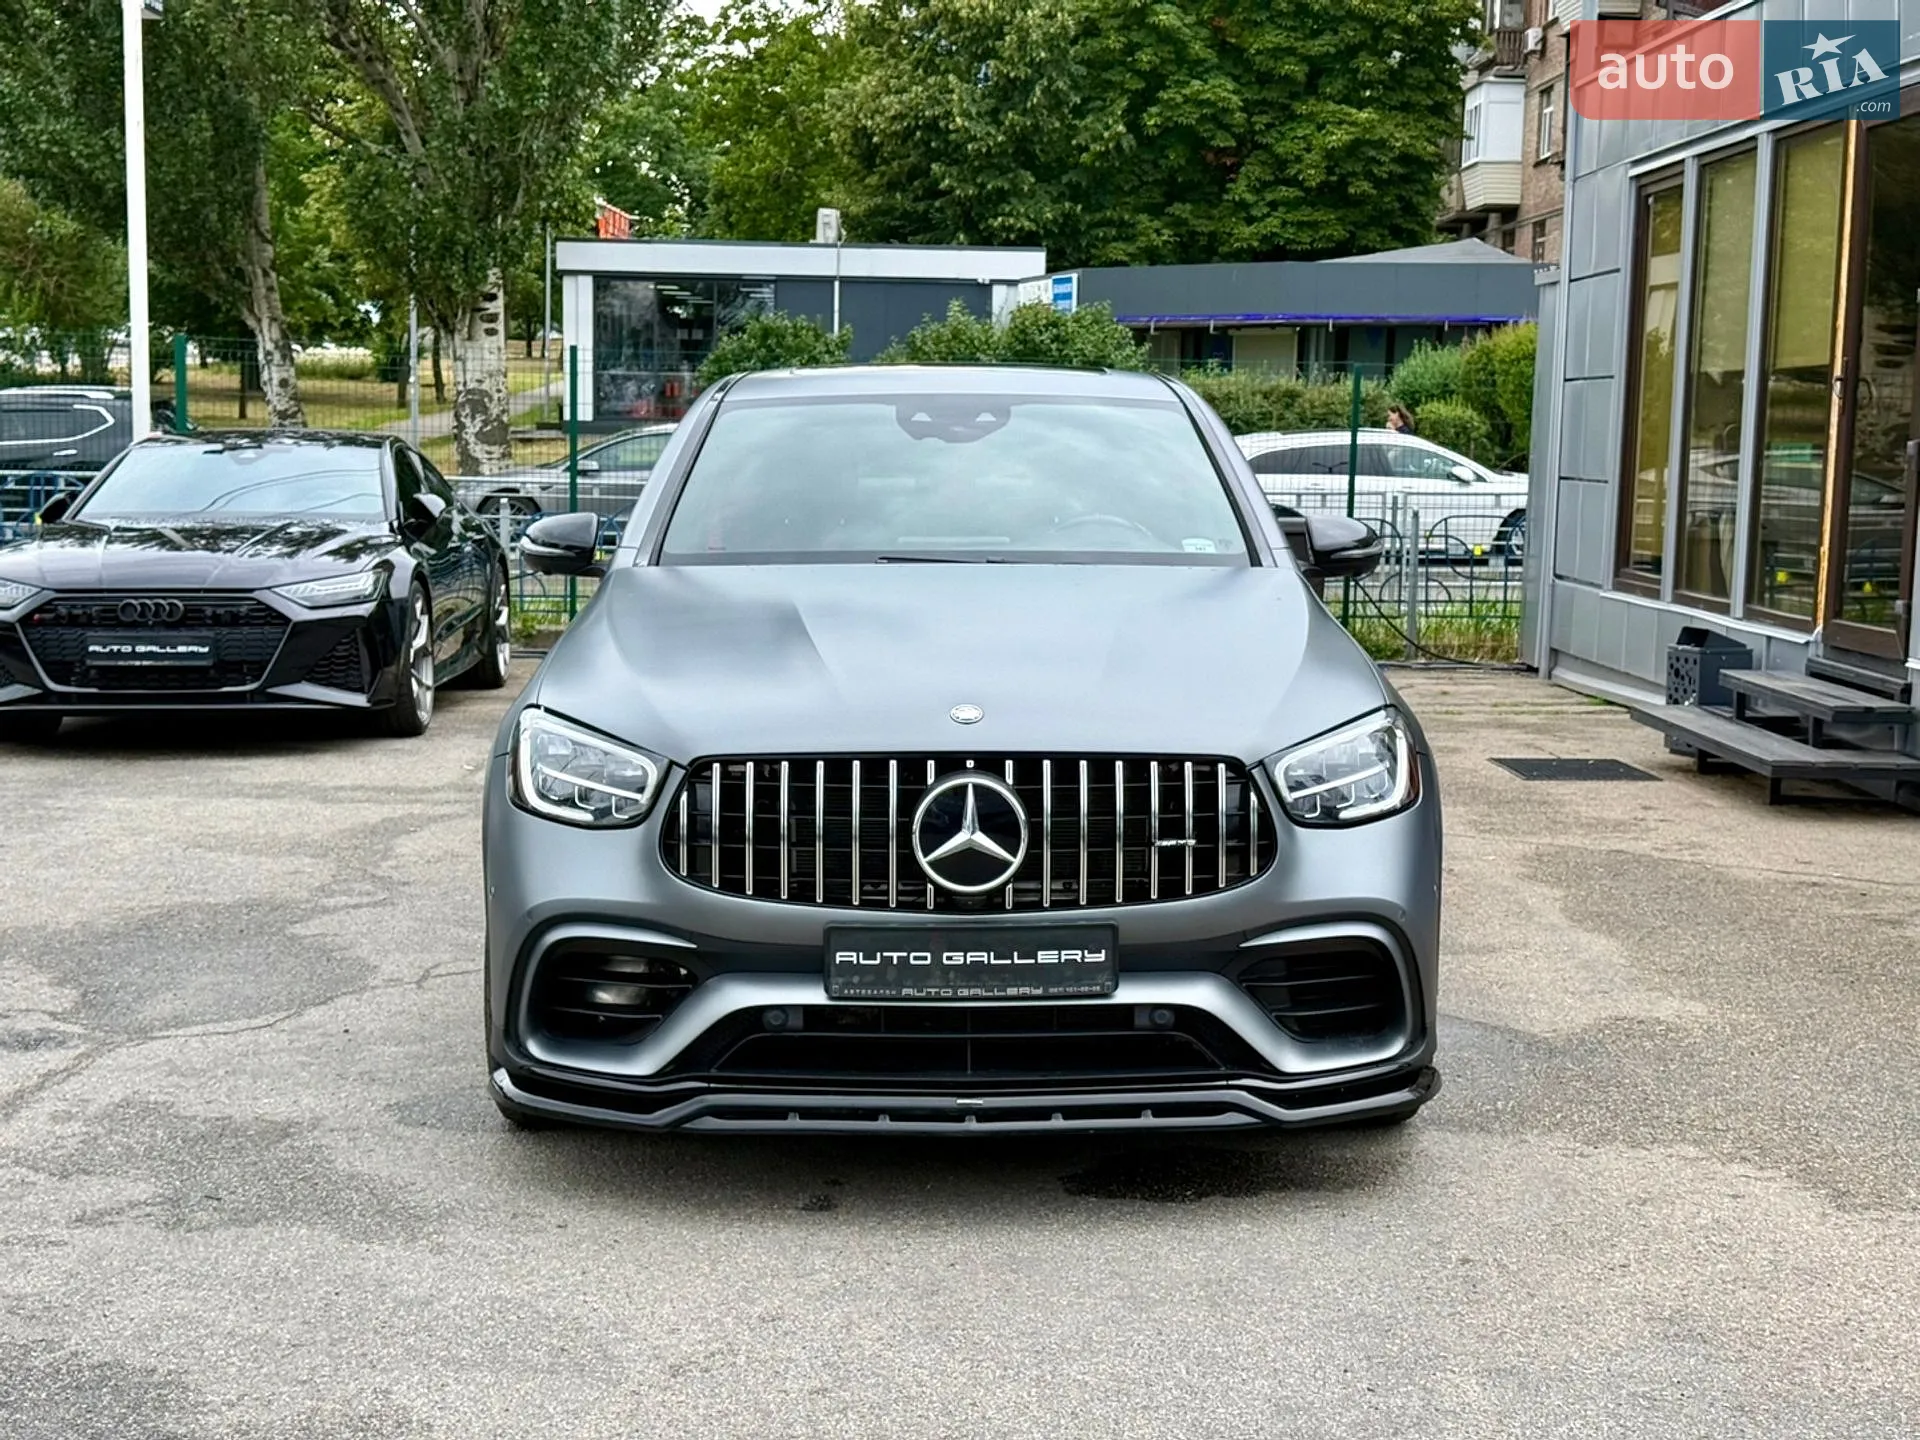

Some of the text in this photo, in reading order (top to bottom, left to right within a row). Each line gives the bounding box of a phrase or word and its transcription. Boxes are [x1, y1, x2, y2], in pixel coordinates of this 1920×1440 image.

[87, 645, 209, 653] AUTO GALLERY
[835, 949, 1106, 966] AUTO GALLERY
[901, 987, 953, 997] AUTO
[957, 986, 1043, 997] GALLERY
